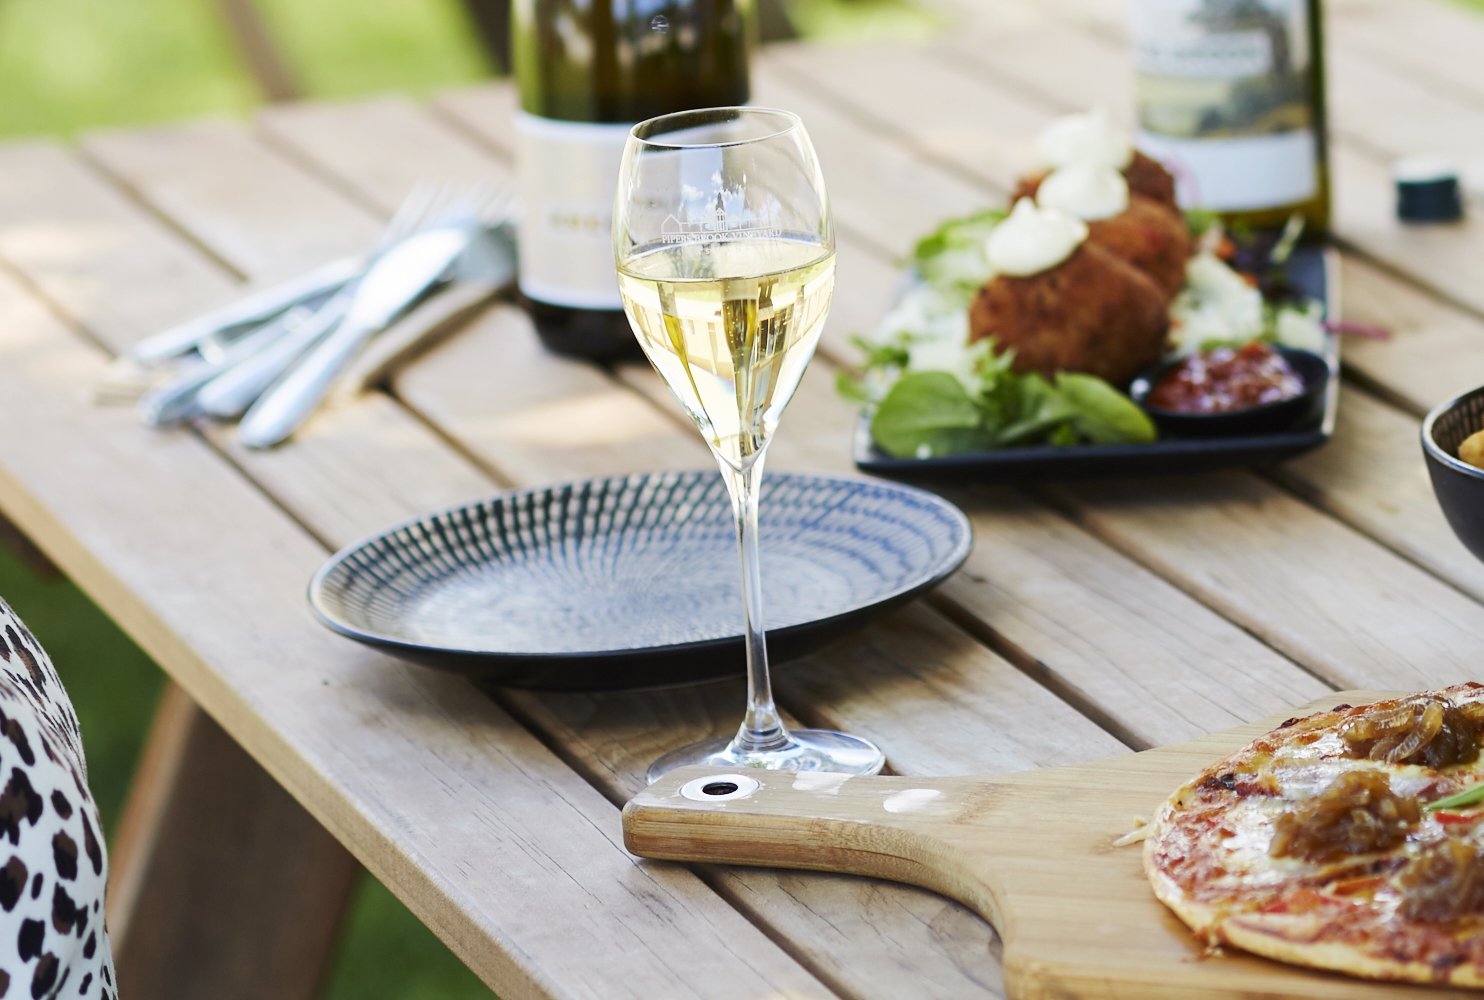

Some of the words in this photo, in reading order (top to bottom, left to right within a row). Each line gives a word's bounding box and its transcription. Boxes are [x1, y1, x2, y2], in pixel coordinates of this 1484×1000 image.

[660, 233, 692, 244] PIPERS
[694, 232, 728, 243] BROOK
[731, 227, 782, 240] VINEYARD
